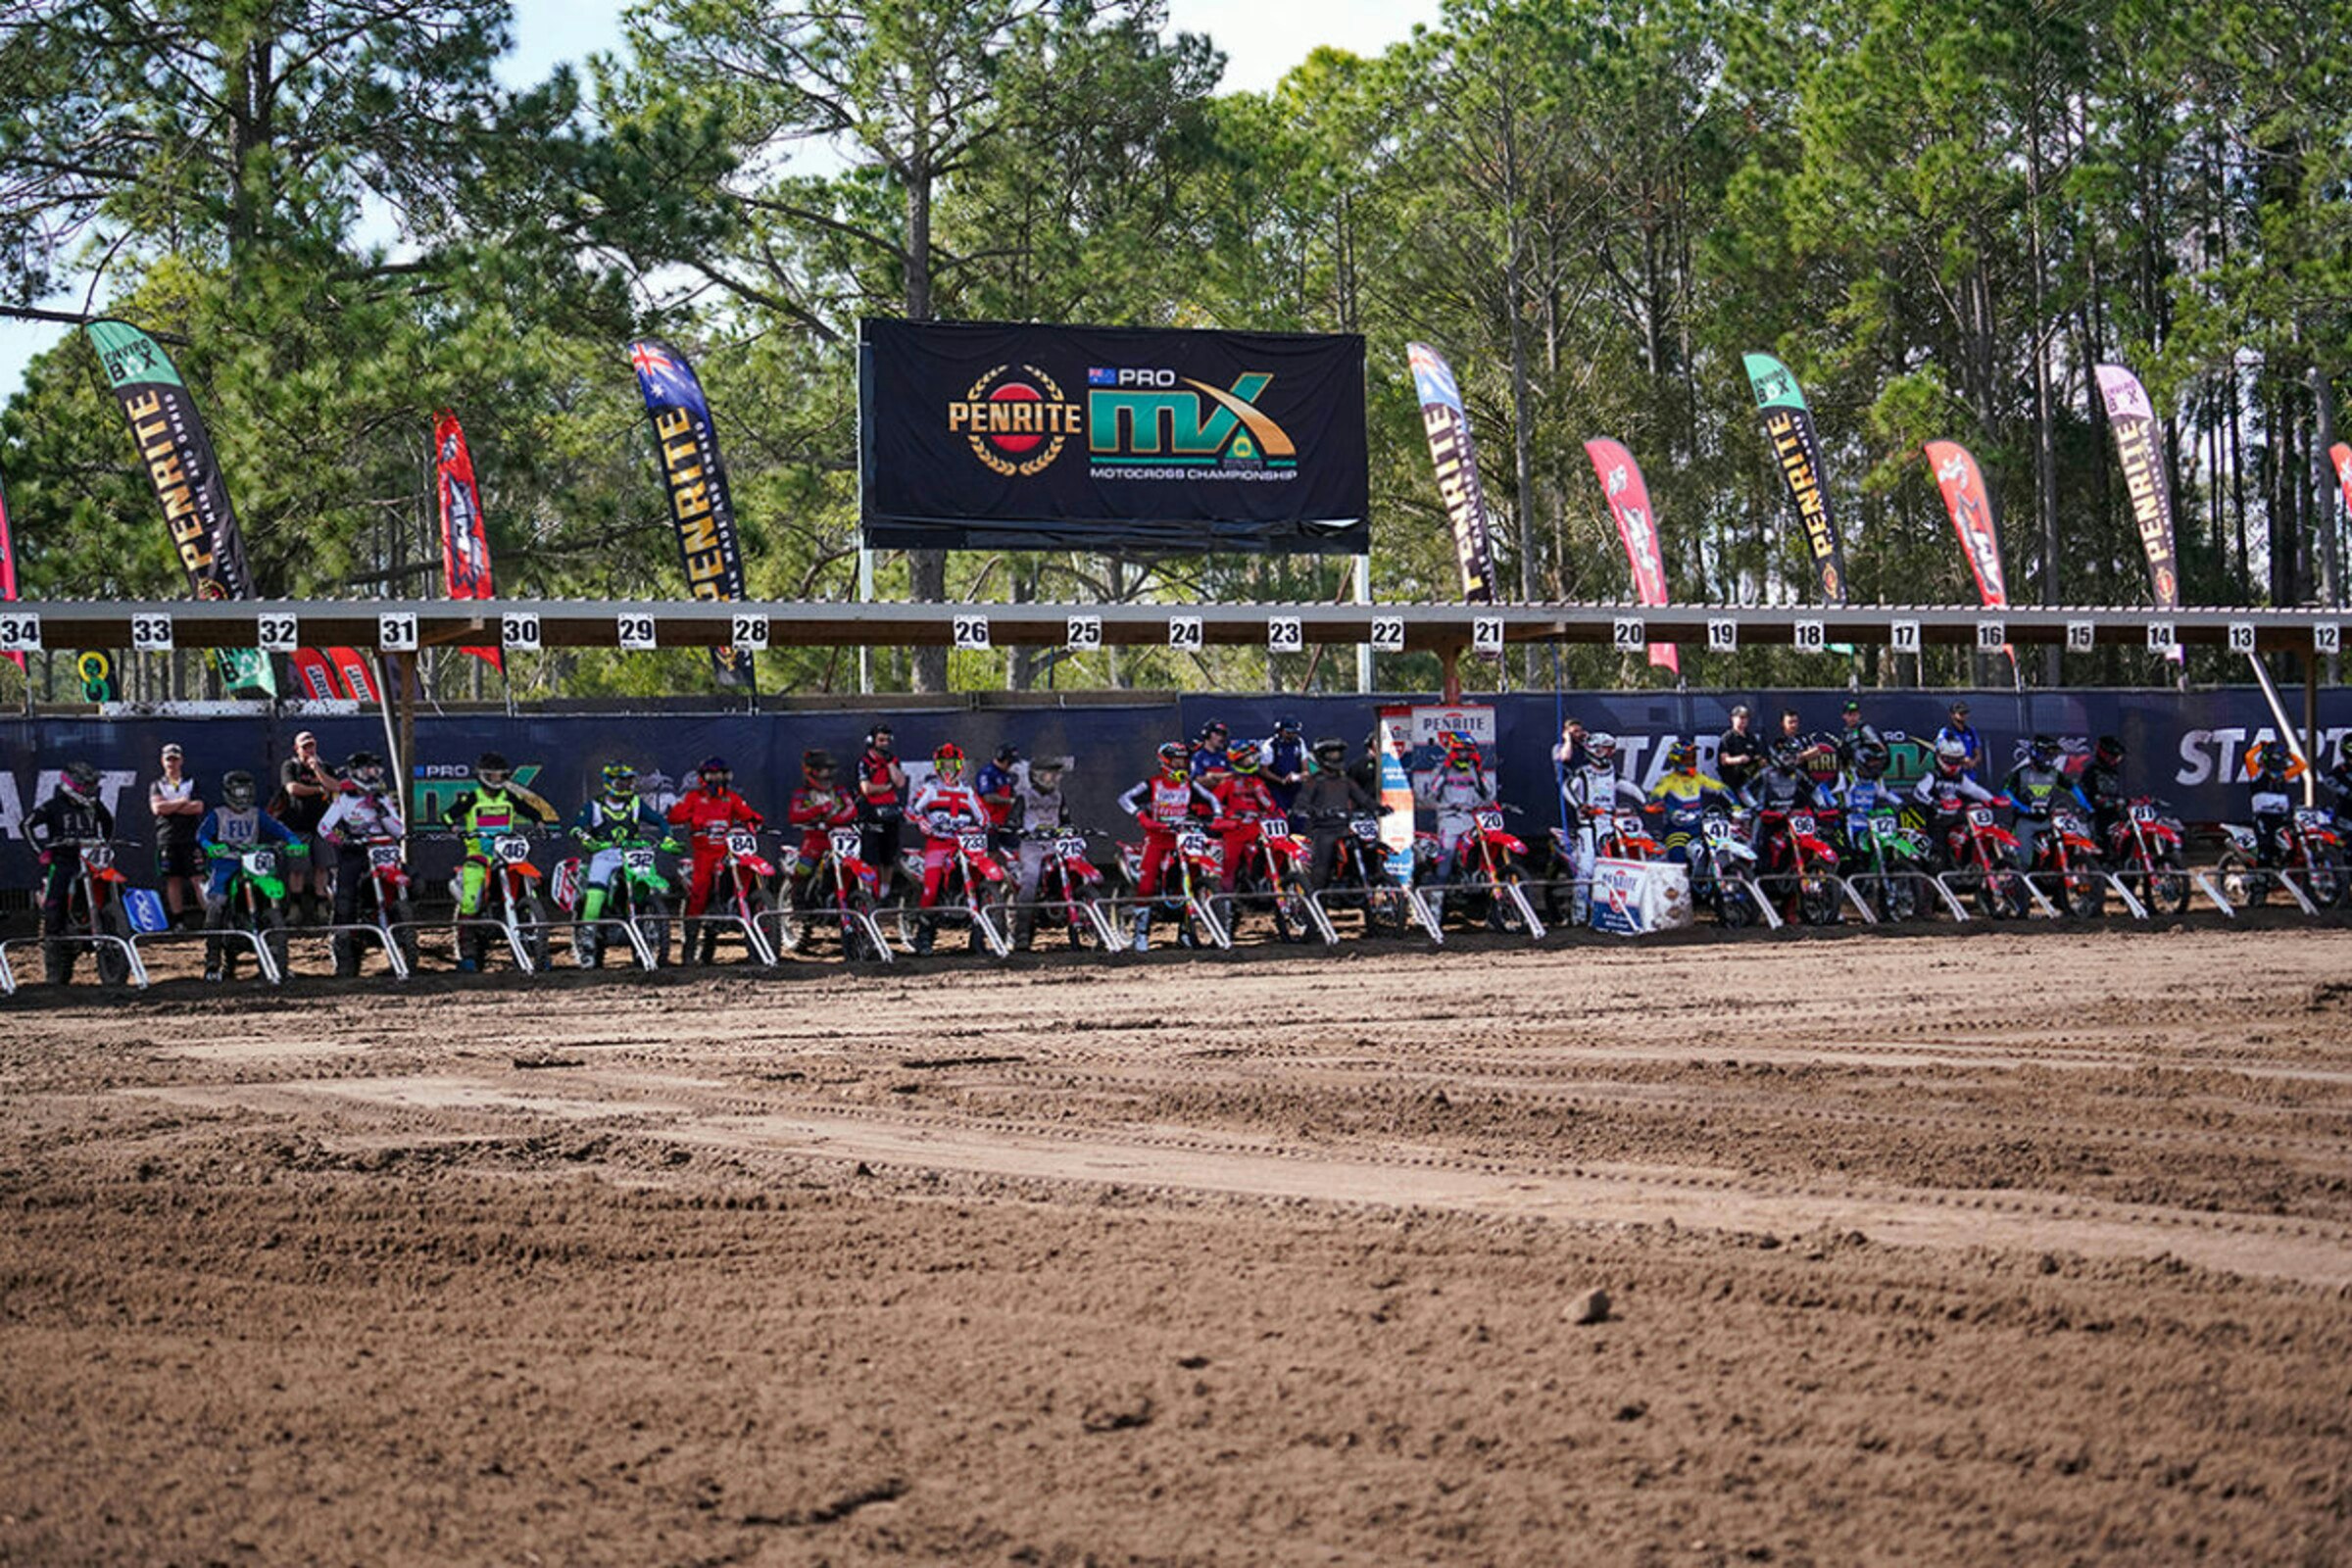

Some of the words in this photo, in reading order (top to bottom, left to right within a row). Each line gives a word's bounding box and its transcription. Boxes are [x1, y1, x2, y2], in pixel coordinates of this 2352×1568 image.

[104, 338, 151, 368] ENVIRO
[1118, 368, 1175, 387] PRO
[949, 400, 1083, 434] PENRITE
[126, 390, 214, 572] PENRITE
[1090, 467, 1185, 480] MOTOCROSS
[1187, 467, 1298, 482] CHAMPIONSHIP
[1767, 412, 1834, 559] PENRITE
[2116, 419, 2169, 564] PENRITE
[656, 407, 730, 601] PENRITE
[2, 620, 38, 643] 34
[134, 619, 171, 642] 33
[261, 619, 295, 643] 32
[383, 619, 414, 642] 31
[503, 619, 538, 643] 30
[619, 619, 653, 642] 29
[735, 619, 766, 642] 28
[956, 621, 987, 643] 26
[1069, 621, 1099, 643] 25
[1171, 622, 1200, 644] 24
[1270, 622, 1298, 644] 23
[1373, 622, 1401, 643] 22
[1477, 621, 1499, 642] 21
[1616, 623, 1642, 644] 20
[1711, 623, 1734, 645] 19
[1797, 625, 1821, 646] 18
[1895, 626, 1914, 645] 17
[1980, 625, 2001, 646] 16
[2071, 626, 2091, 646] 15
[2150, 627, 2171, 646] 14
[2231, 627, 2252, 647] 13
[2317, 627, 2336, 647] 12
[1423, 716, 1484, 732] PENRITE
[2176, 727, 2352, 786] STAT
[426, 764, 469, 777] PRO
[63, 813, 95, 830] FLY
[228, 818, 253, 839] FLY
[1482, 812, 1501, 829] 20
[502, 842, 526, 858] 46
[732, 837, 756, 853] 84
[837, 835, 859, 852] 17
[628, 853, 654, 868] 32
